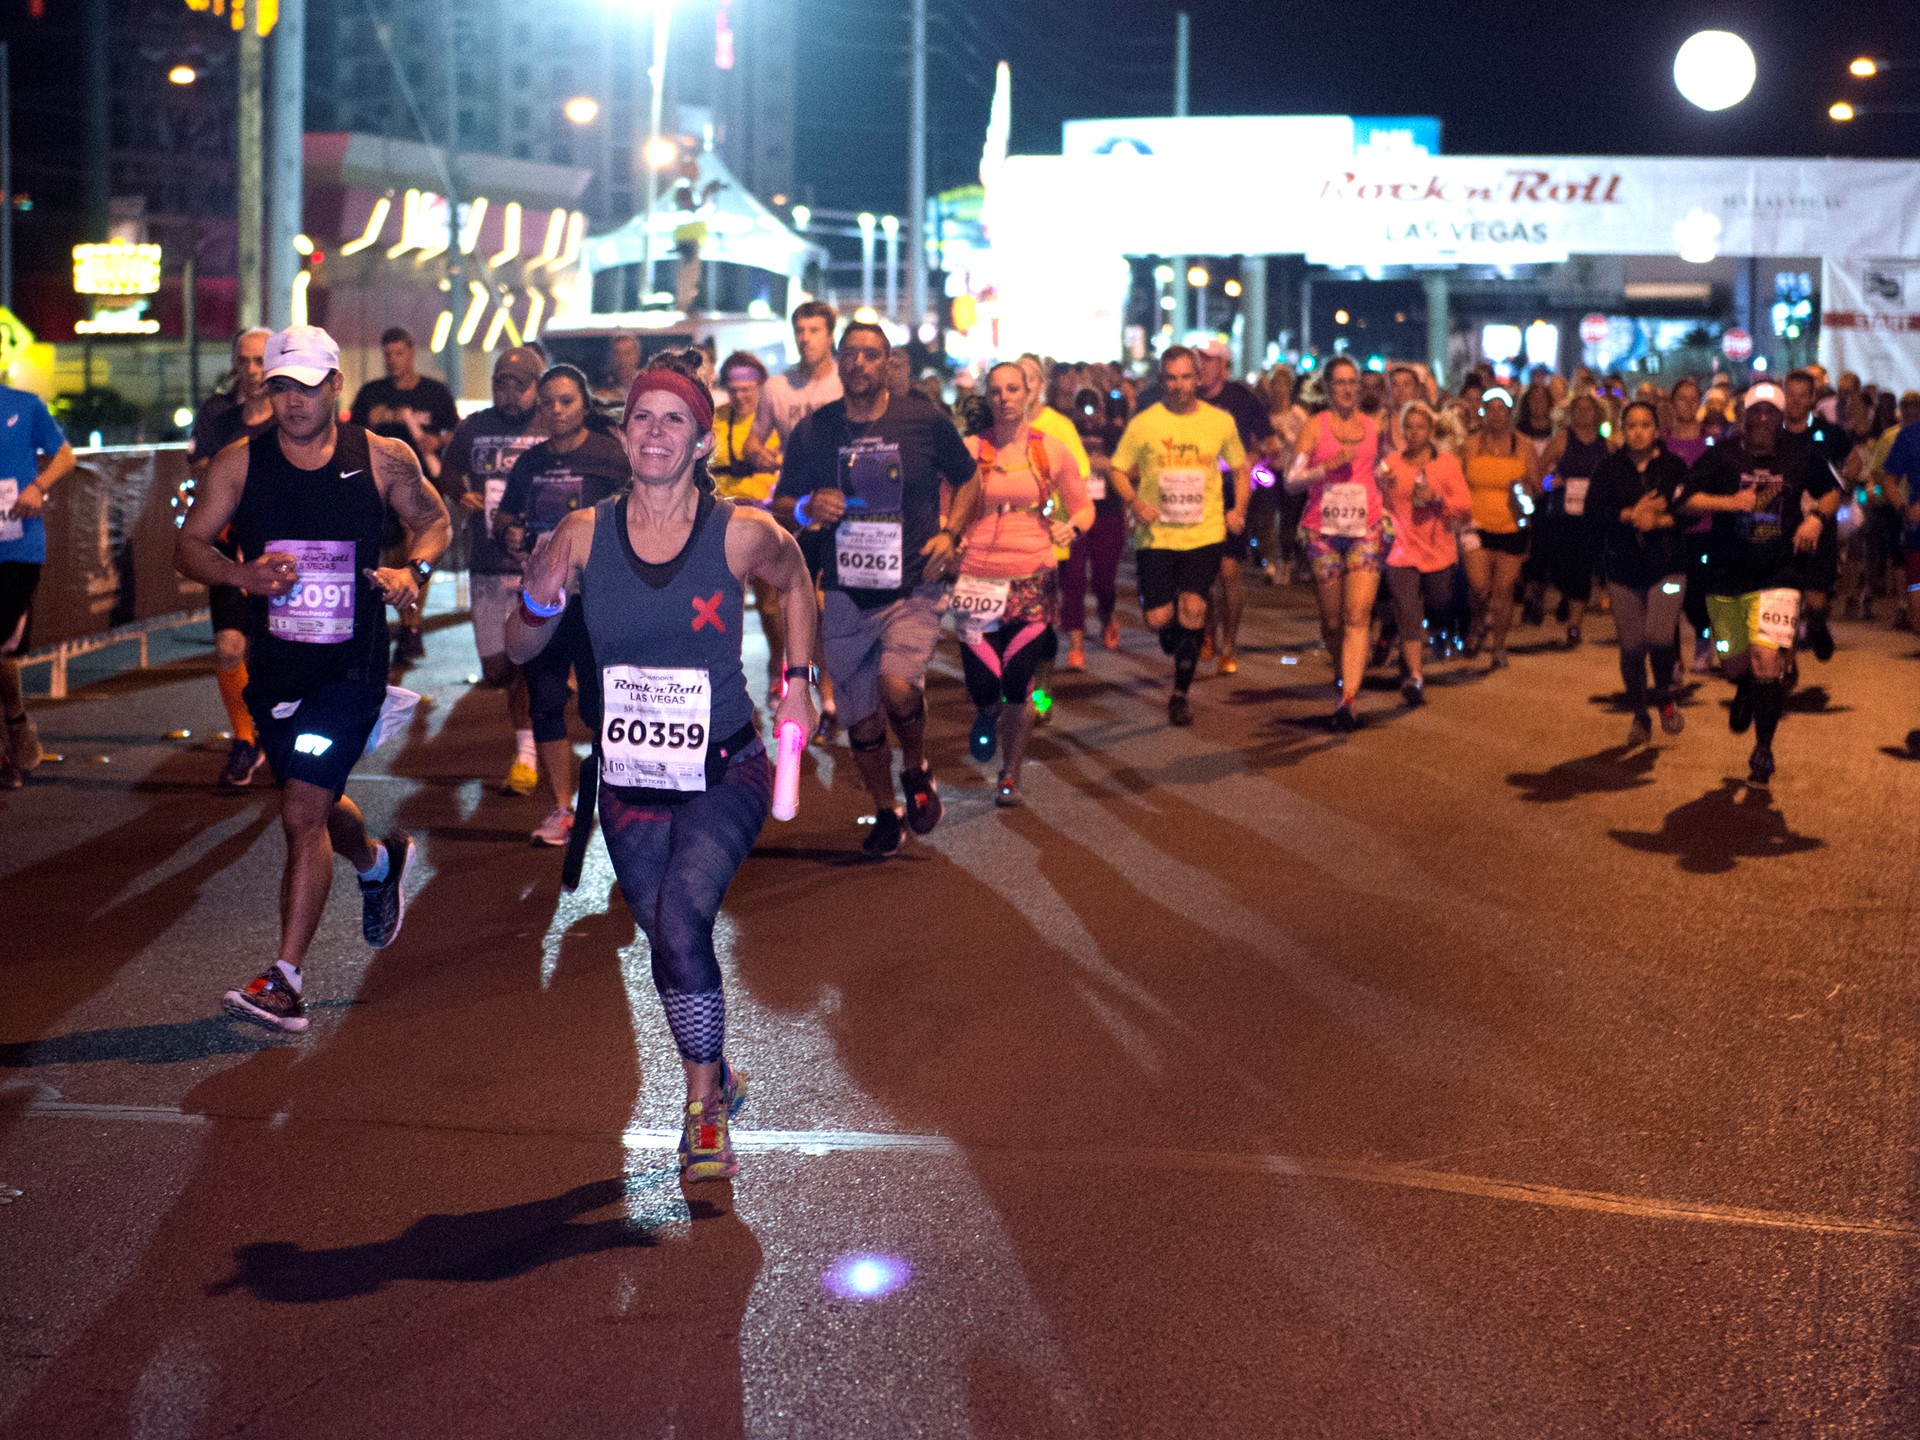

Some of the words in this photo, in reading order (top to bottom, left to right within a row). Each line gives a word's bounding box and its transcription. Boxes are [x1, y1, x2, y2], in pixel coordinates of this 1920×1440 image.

[1507, 170, 1624, 204] Roll
[1386, 219, 1438, 242] LAS
[1450, 220, 1549, 244] VEGAS
[840, 551, 900, 571] 60262
[953, 595, 1003, 613] 60107
[613, 679, 653, 694] Rock
[667, 683, 703, 695] Roll
[630, 692, 648, 703] LAS
[650, 694, 687, 705] VEGAS
[607, 718, 705, 750] 60359
[614, 762, 625, 772] 10
